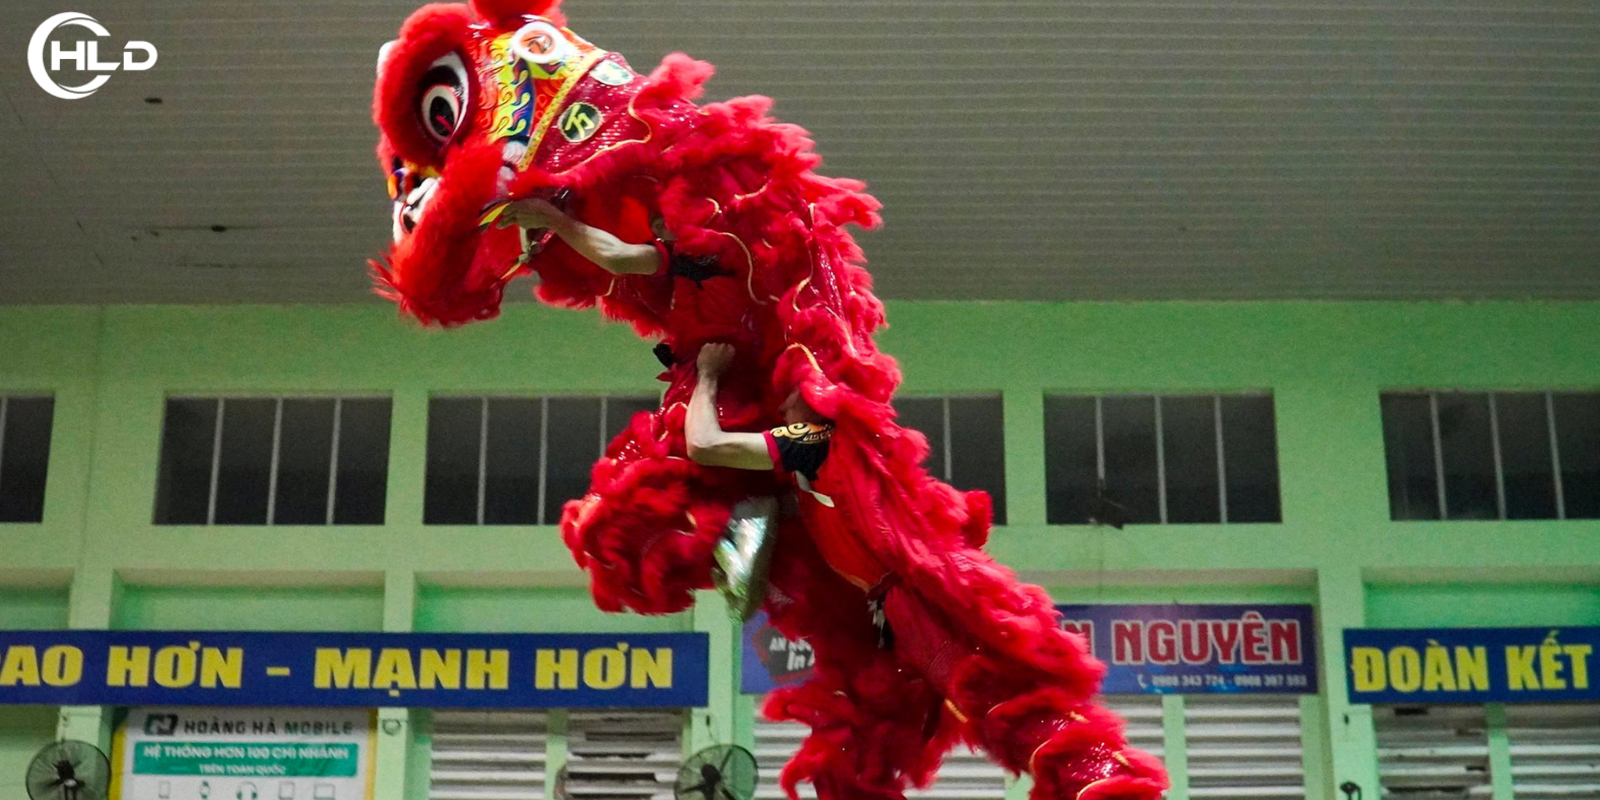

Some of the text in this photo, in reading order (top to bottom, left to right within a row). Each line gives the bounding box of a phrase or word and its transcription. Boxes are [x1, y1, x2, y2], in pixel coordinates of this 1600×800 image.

[1111, 611, 1301, 665] NGUYÊN
[1351, 630, 1593, 692] ĐOÀN KẾT
[0, 645, 84, 687] AO
[106, 641, 244, 688] HƠN
[313, 647, 510, 697] MẠNH
[534, 642, 673, 689] HƠN
[143, 743, 161, 760] HỆ
[246, 746, 271, 759] 100
[271, 746, 297, 759] CHI
[183, 716, 353, 735] HOÀNG HÀ MOBILE
